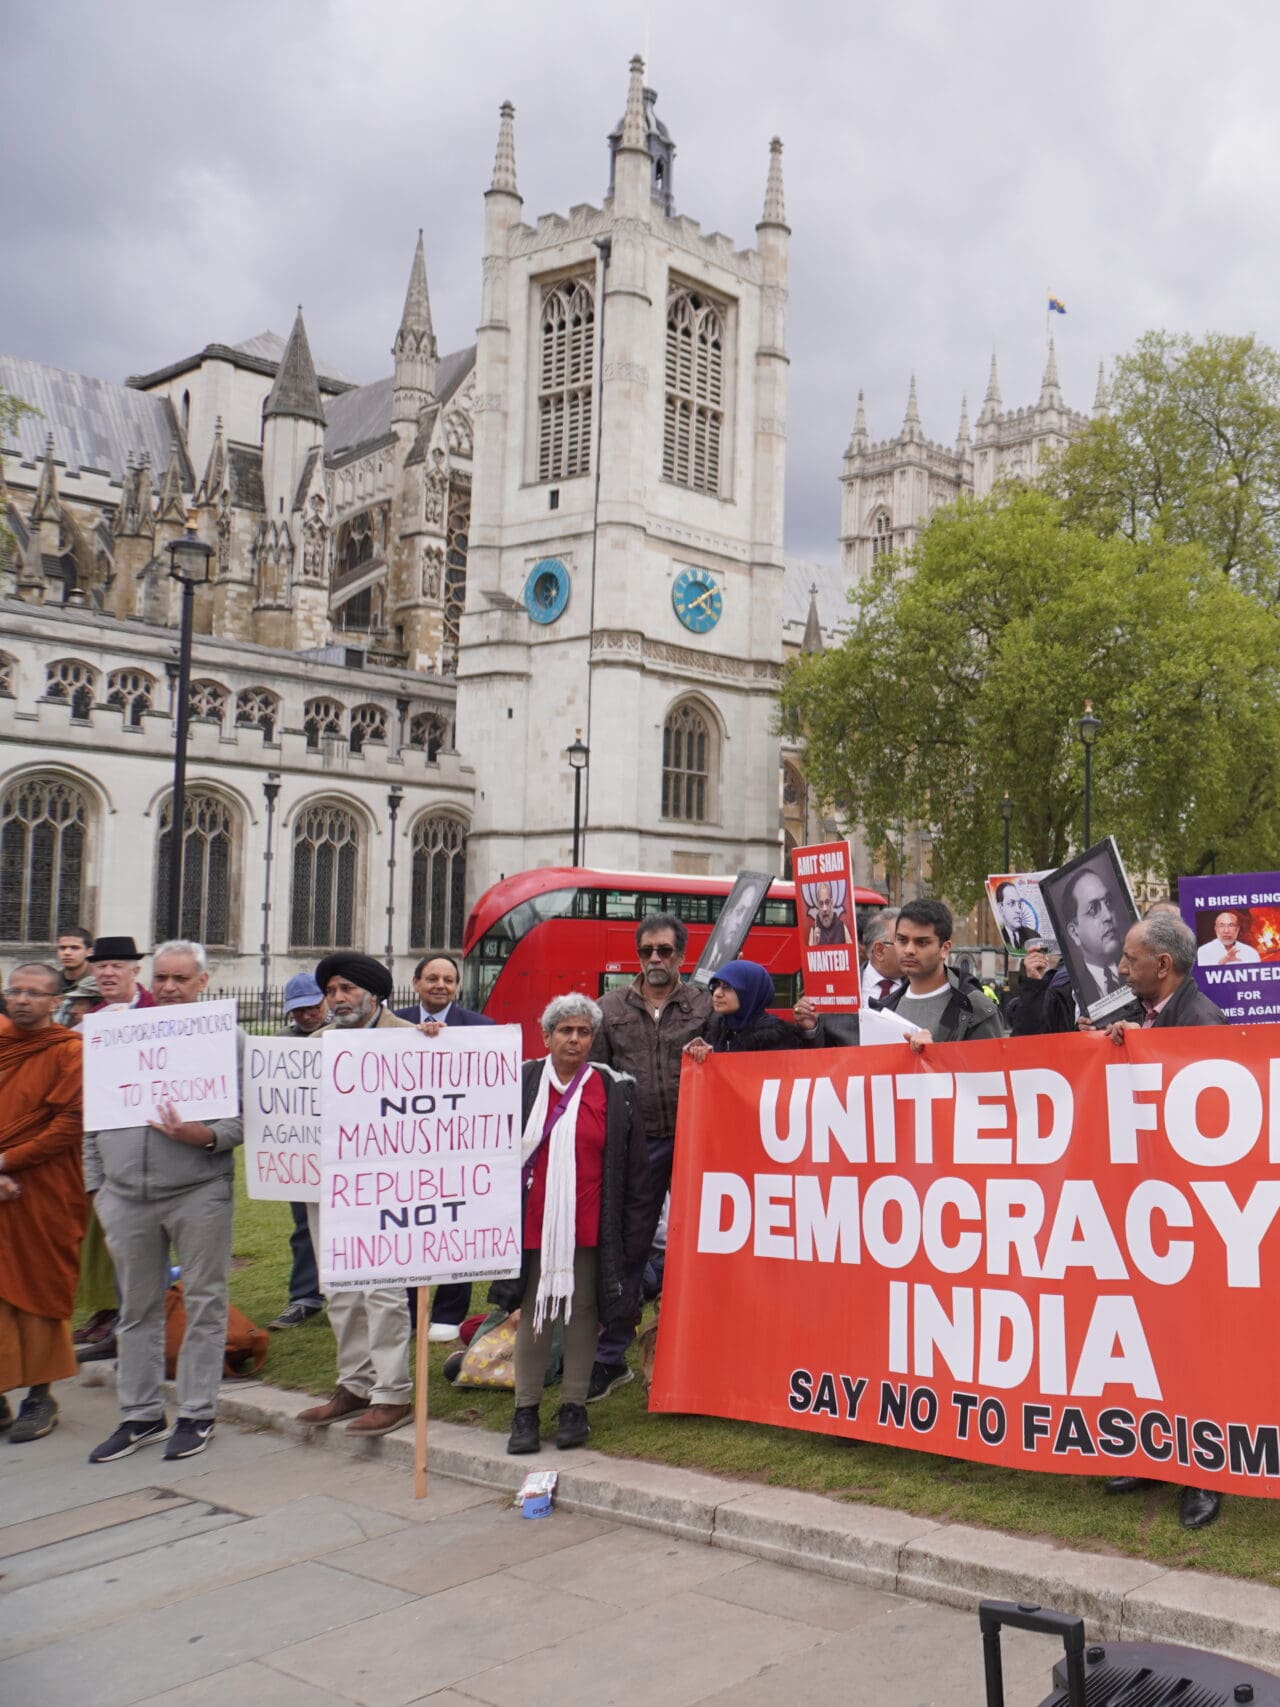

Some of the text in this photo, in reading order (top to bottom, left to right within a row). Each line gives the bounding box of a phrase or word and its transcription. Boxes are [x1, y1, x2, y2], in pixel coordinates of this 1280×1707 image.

[797, 851, 845, 876] AMIT SHAH
[1194, 897, 1205, 907] N
[1208, 894, 1248, 907] BIREN
[806, 949, 850, 973] WANTED!
[1236, 990, 1262, 1001] FOR
[138, 1047, 168, 1071] NO
[332, 1050, 518, 1095] CONSTITUTION
[118, 1075, 228, 1107] TO FASCISM!
[258, 1086, 321, 1117] UNITE
[380, 1094, 467, 1117] NOT
[759, 1067, 1075, 1165] UNITED
[338, 1113, 515, 1160] MANUSMRITI!
[331, 1164, 492, 1208] REPUBLIC
[379, 1200, 467, 1231] NOT
[332, 1226, 520, 1272] HINDU RASHTRA
[888, 1280, 1164, 1401] INDIA
[787, 1368, 869, 1420] SAY
[877, 1380, 938, 1433] NO
[950, 1391, 1008, 1446] TO
